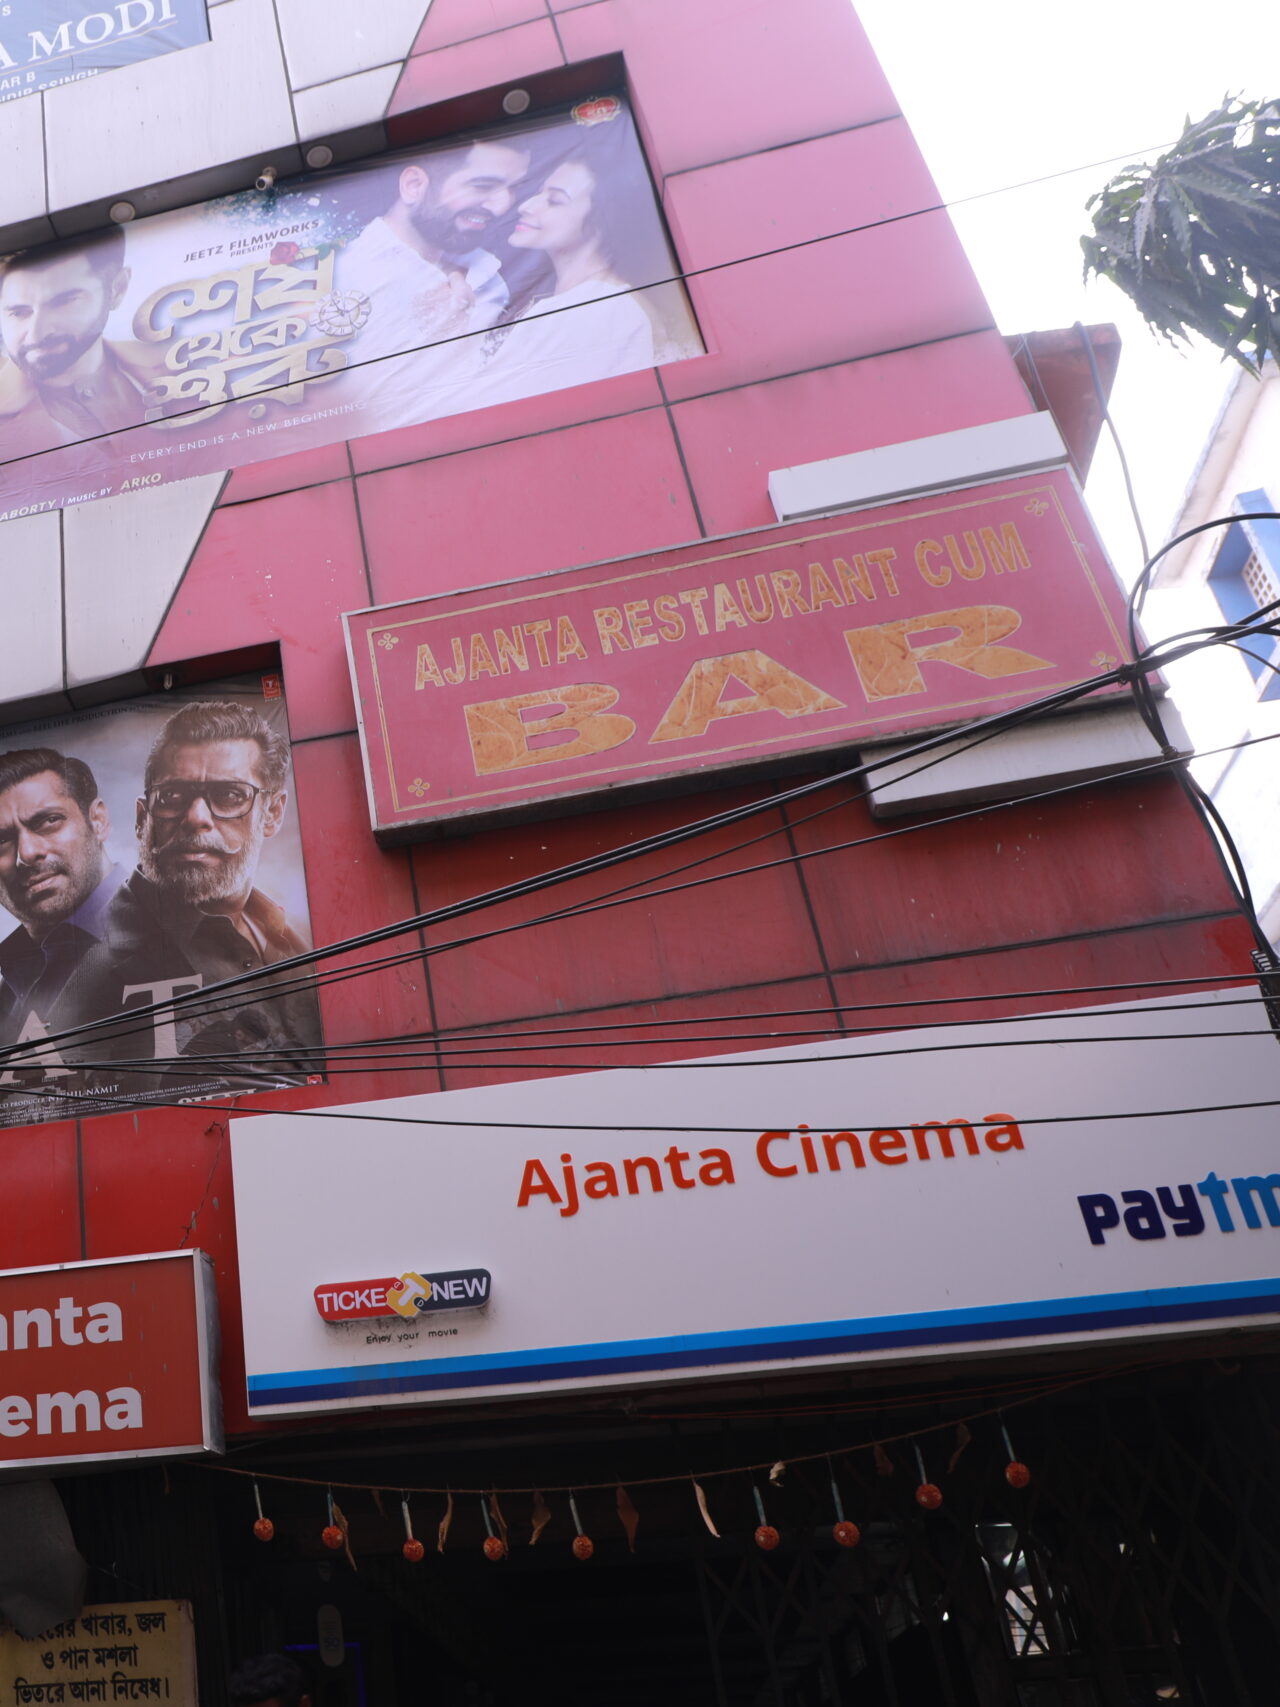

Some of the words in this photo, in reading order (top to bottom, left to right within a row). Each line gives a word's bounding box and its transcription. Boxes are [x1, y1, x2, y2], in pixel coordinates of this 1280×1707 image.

[27, 0, 177, 62] MODI
[26, 71, 36, 83] B
[183, 244, 224, 263] JEETZ
[229, 218, 320, 251] FILMWORKS
[229, 241, 275, 258] PRESENTS
[164, 316, 308, 370] থেকে
[130, 446, 171, 463] EVERY
[179, 439, 208, 453] END
[213, 435, 225, 445] IS
[231, 431, 241, 441] A
[246, 422, 278, 437] NEW
[283, 400, 369, 428] BEGINNING
[67, 491, 98, 505] MUSIC
[99, 486, 114, 497] BY
[120, 472, 163, 490] ARKO
[412, 613, 589, 691] AJANTA
[591, 546, 898, 656] RESTAURANT
[912, 520, 1033, 589] CUM
[462, 604, 1058, 777] BAR
[71, 706, 129, 725] PRODUCTION
[86, 1084, 120, 1096] NAMIT
[515, 1141, 736, 1217] Ajanta
[755, 1112, 1026, 1180] Cinema
[1077, 1171, 1280, 1245] paytm
[431, 1276, 488, 1302] NEW
[366, 1334, 392, 1345] Enjoy
[397, 1331, 420, 1343] your
[428, 1327, 459, 1338] movie
[81, 1611, 132, 1636] খাবার,
[135, 1612, 167, 1634] জল
[40, 1650, 55, 1670] ও
[60, 1647, 90, 1670] পান
[92, 1643, 139, 1668] মশলা
[13, 1676, 65, 1706] ভিতরে
[69, 1677, 108, 1702] আনা
